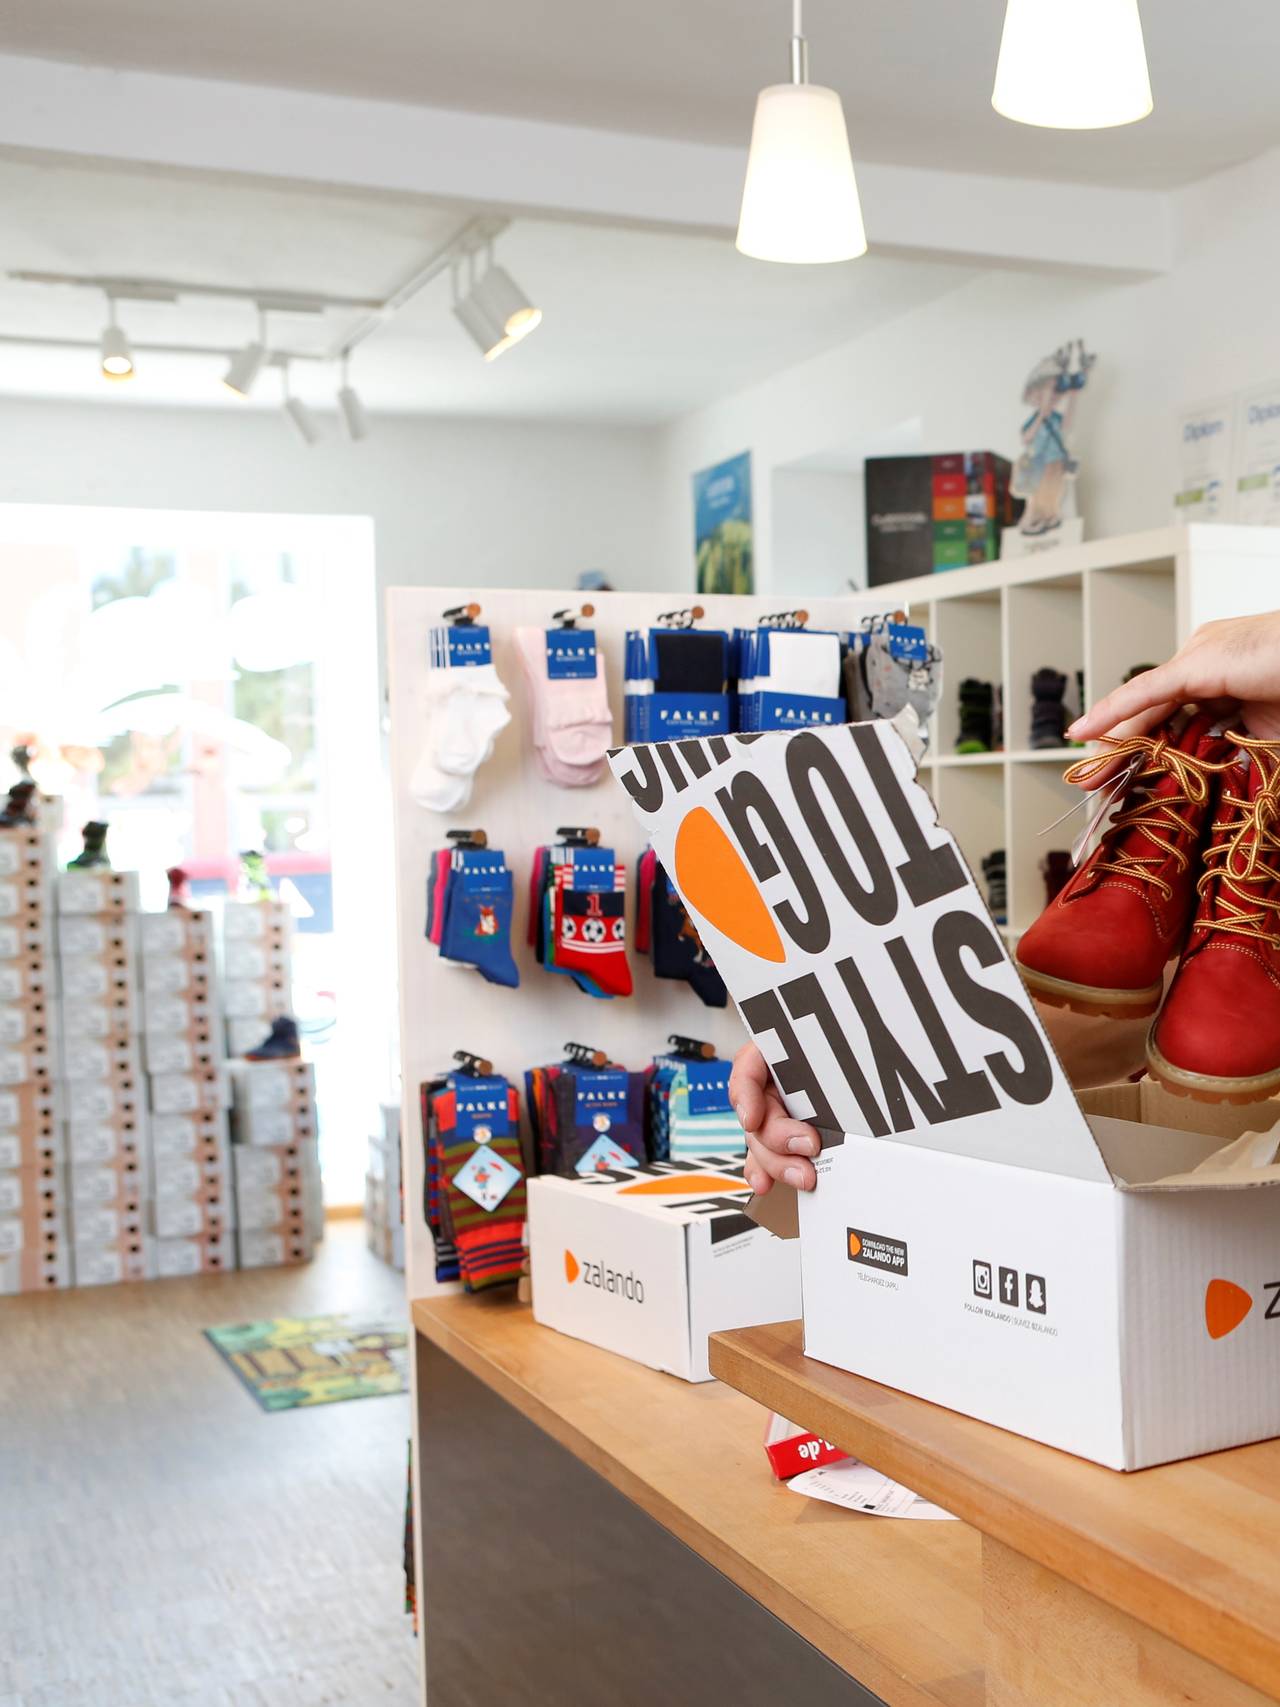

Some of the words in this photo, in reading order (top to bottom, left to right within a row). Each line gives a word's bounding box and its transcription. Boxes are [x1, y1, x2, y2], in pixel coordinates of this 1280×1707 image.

[660, 709, 720, 721] FALKE
[774, 708, 832, 722] FALKE
[738, 910, 1054, 1151] STYLE
[687, 1080, 730, 1092] FALK
[577, 1091, 626, 1101] FALKE
[456, 1101, 507, 1112] FALKE
[862, 1247, 892, 1264] ZALANDO
[891, 1254, 905, 1268] APP
[581, 1260, 645, 1304] zalando
